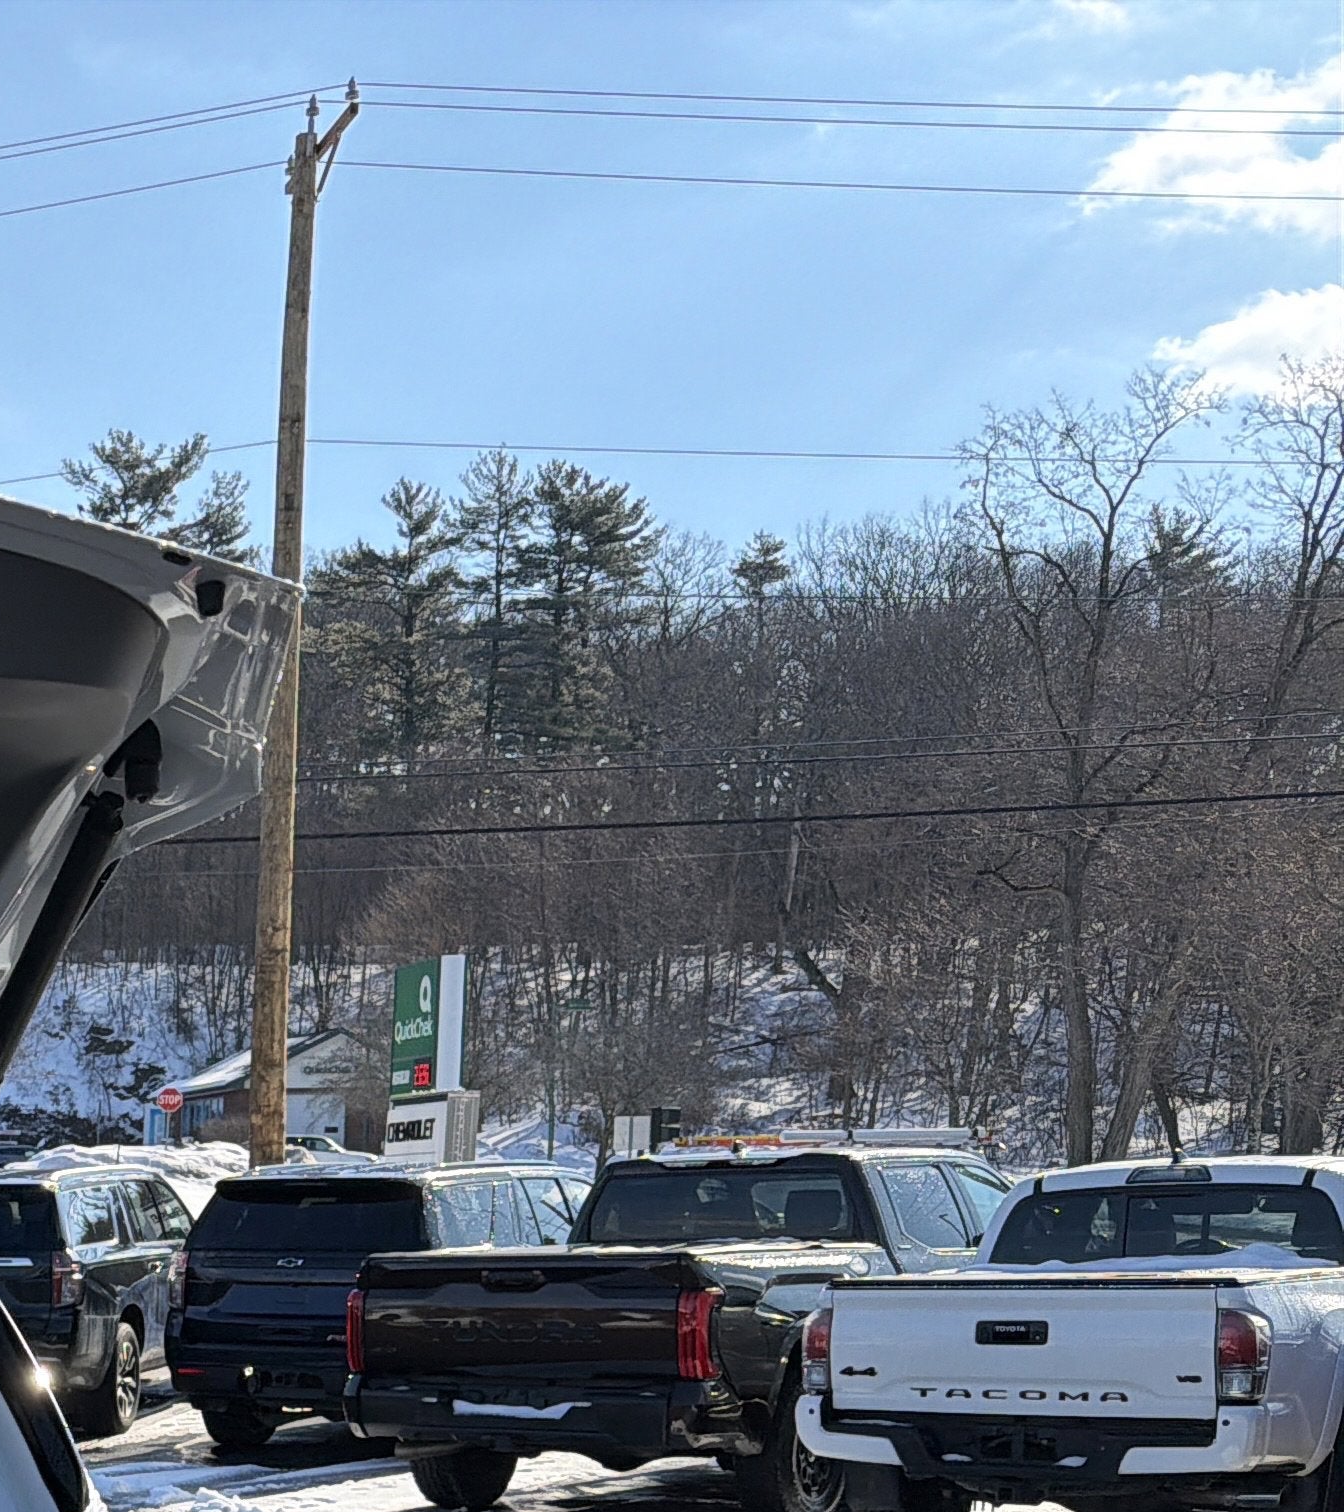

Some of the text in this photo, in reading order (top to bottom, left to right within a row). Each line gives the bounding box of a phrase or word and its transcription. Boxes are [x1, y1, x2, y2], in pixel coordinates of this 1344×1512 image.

[394, 1016, 433, 1045] QuickChek
[158, 1094, 181, 1105] STOP
[387, 1118, 435, 1144] CHEVROLET
[994, 1325, 1026, 1333] TOYOTA
[909, 1387, 1129, 1402] TACOMA
